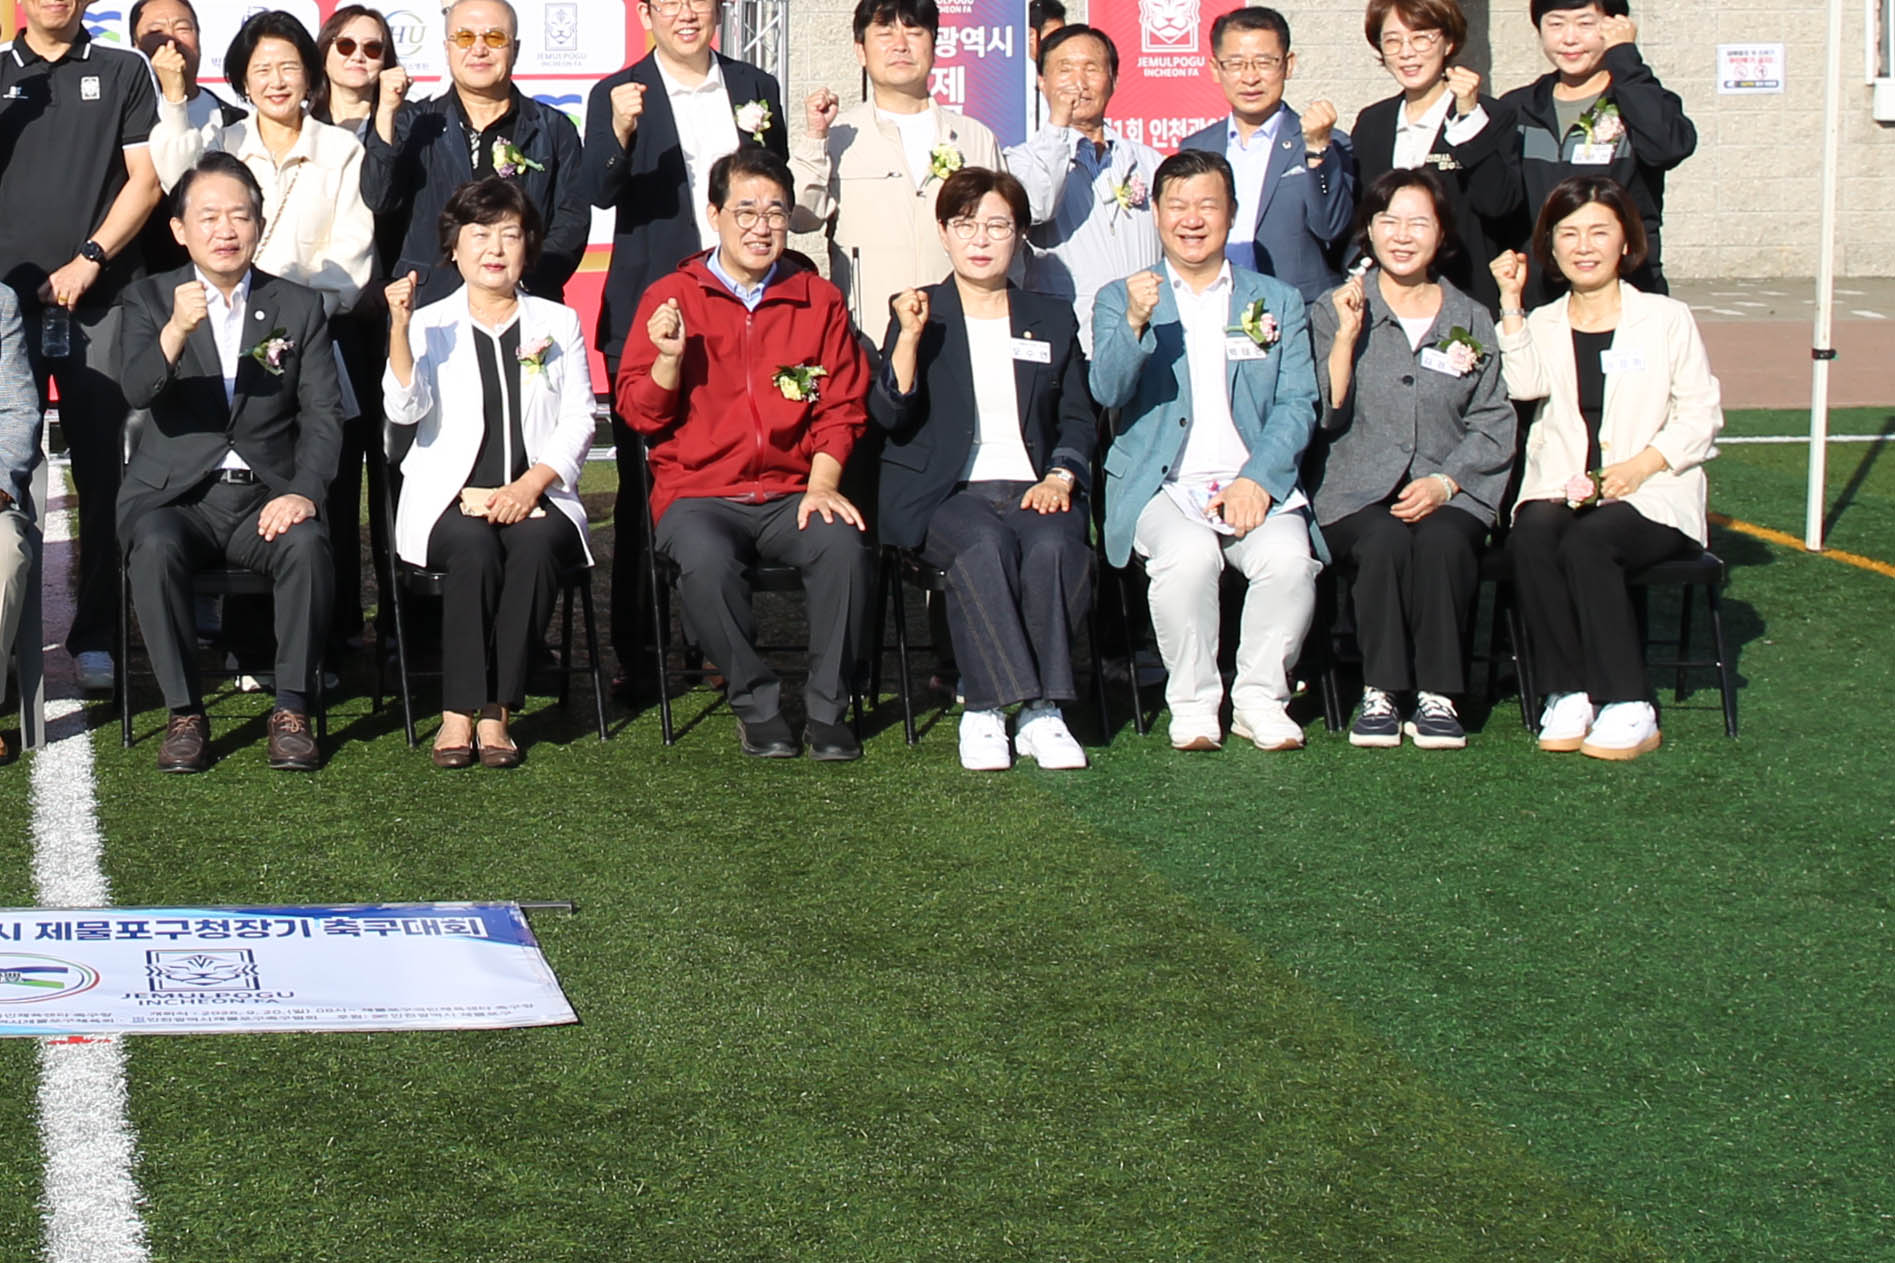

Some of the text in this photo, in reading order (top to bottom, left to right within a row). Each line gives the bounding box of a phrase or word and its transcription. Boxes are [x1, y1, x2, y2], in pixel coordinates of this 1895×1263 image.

[935, 25, 1013, 58] 광역시
[1138, 56, 1205, 67] JEMULPOGU
[1144, 68, 1200, 77] INCHEON FA
[35, 919, 312, 942] 제물포구청장기
[324, 916, 480, 938] 축구대회
[120, 991, 295, 1000] JEMULPOGU
